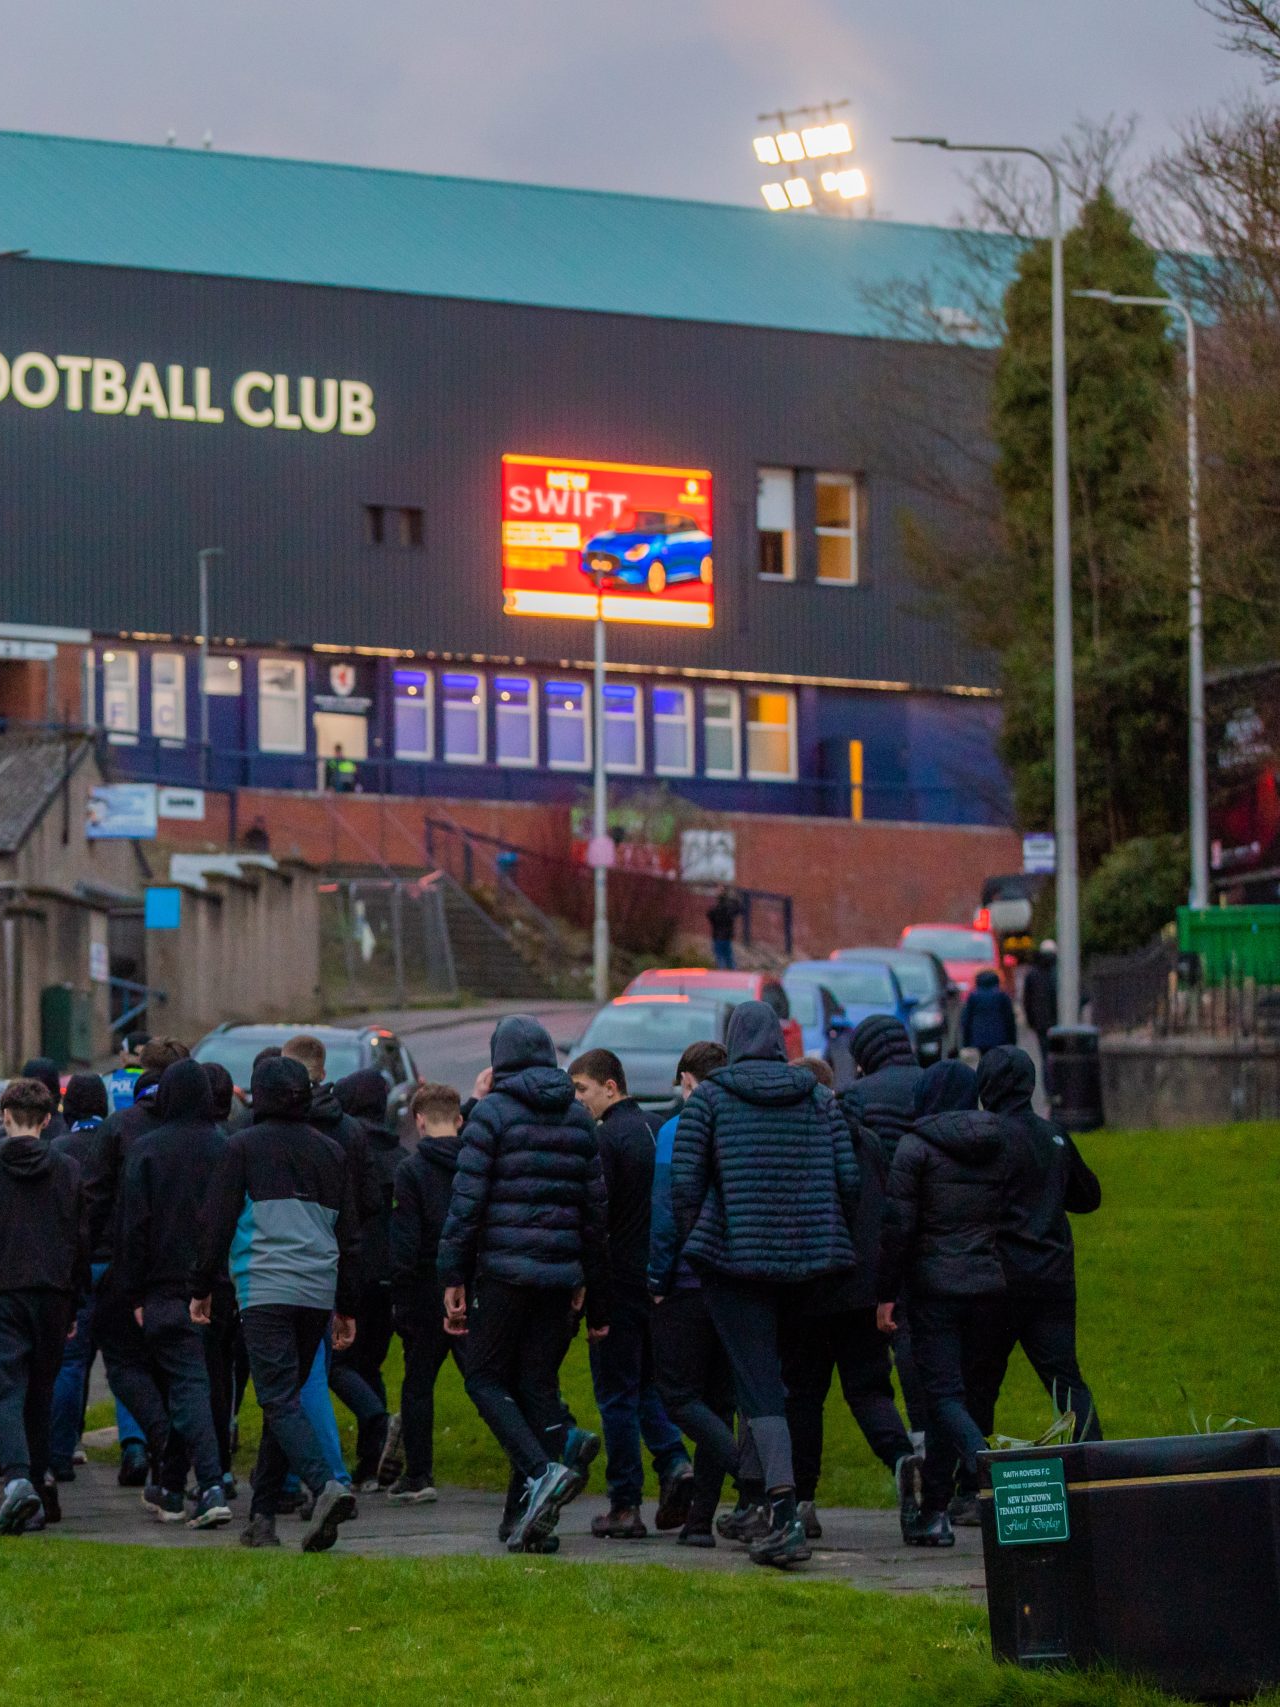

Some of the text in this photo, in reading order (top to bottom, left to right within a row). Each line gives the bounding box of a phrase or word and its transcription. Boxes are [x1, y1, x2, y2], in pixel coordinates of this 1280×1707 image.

[231, 371, 376, 436] CLUB
[508, 486, 629, 518] SWIFT
[110, 1079, 135, 1093] POL
[1002, 1470, 1018, 1478] RAITH
[1019, 1469, 1040, 1477] ROVERS
[1007, 1493, 1051, 1504] NEW LINKTOWN
[999, 1506, 1024, 1515] TENANTS
[1031, 1503, 1063, 1513] RESIDENTS
[1004, 1517, 1060, 1535] Floral Display
